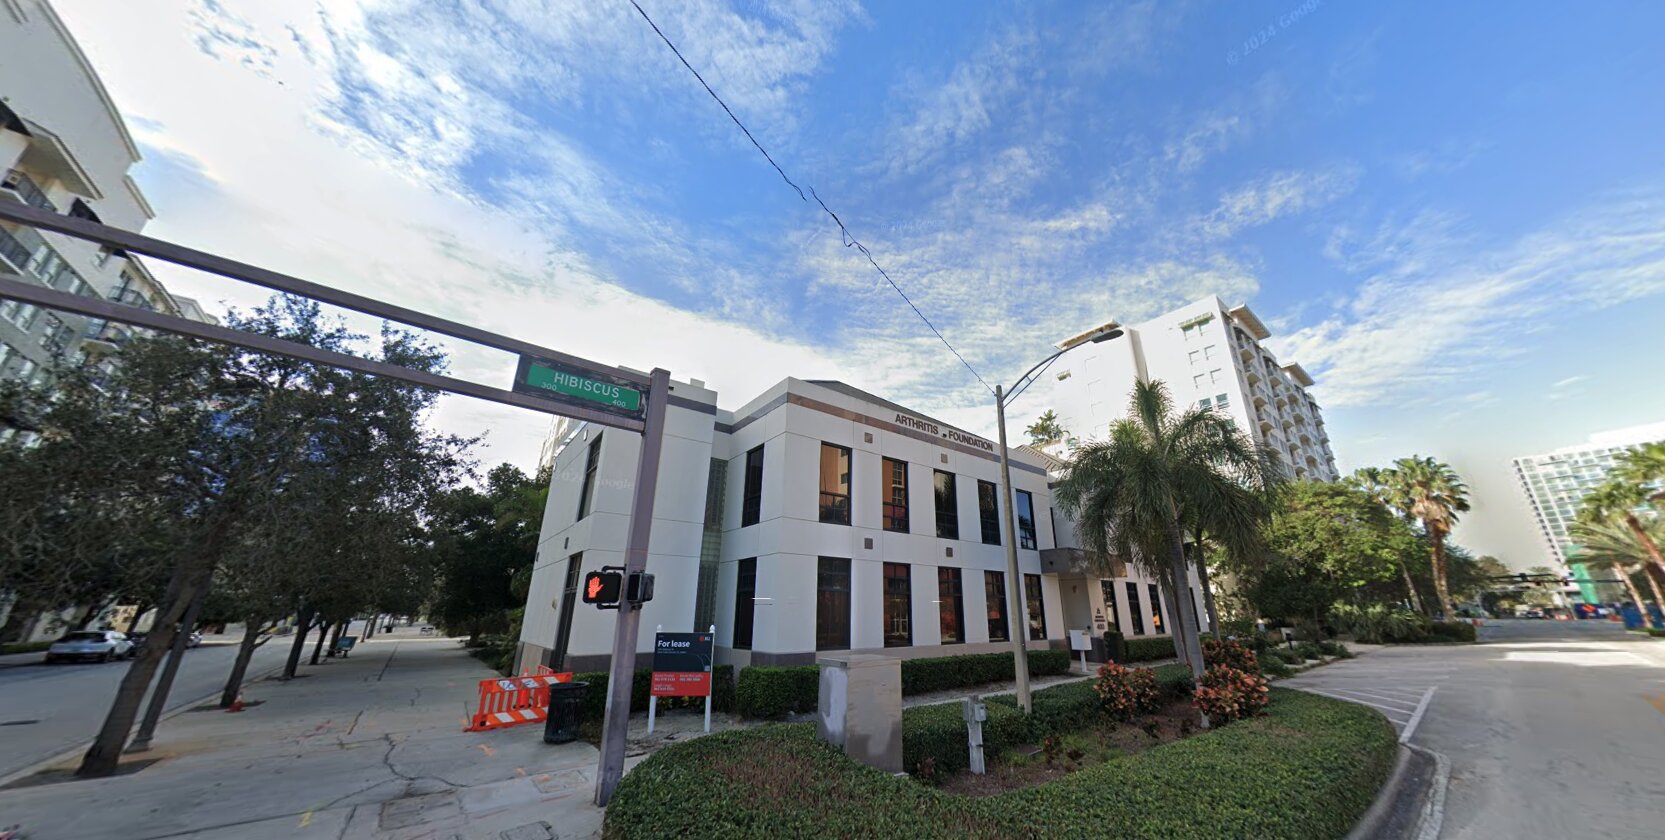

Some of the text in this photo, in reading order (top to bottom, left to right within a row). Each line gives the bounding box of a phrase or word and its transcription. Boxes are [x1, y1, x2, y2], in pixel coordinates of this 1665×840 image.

[541, 382, 557, 391] 300
[554, 372, 619, 398] HIBISCUS
[612, 399, 626, 408] 400
[895, 414, 993, 452] ARTHRITIS FOUNDATION
